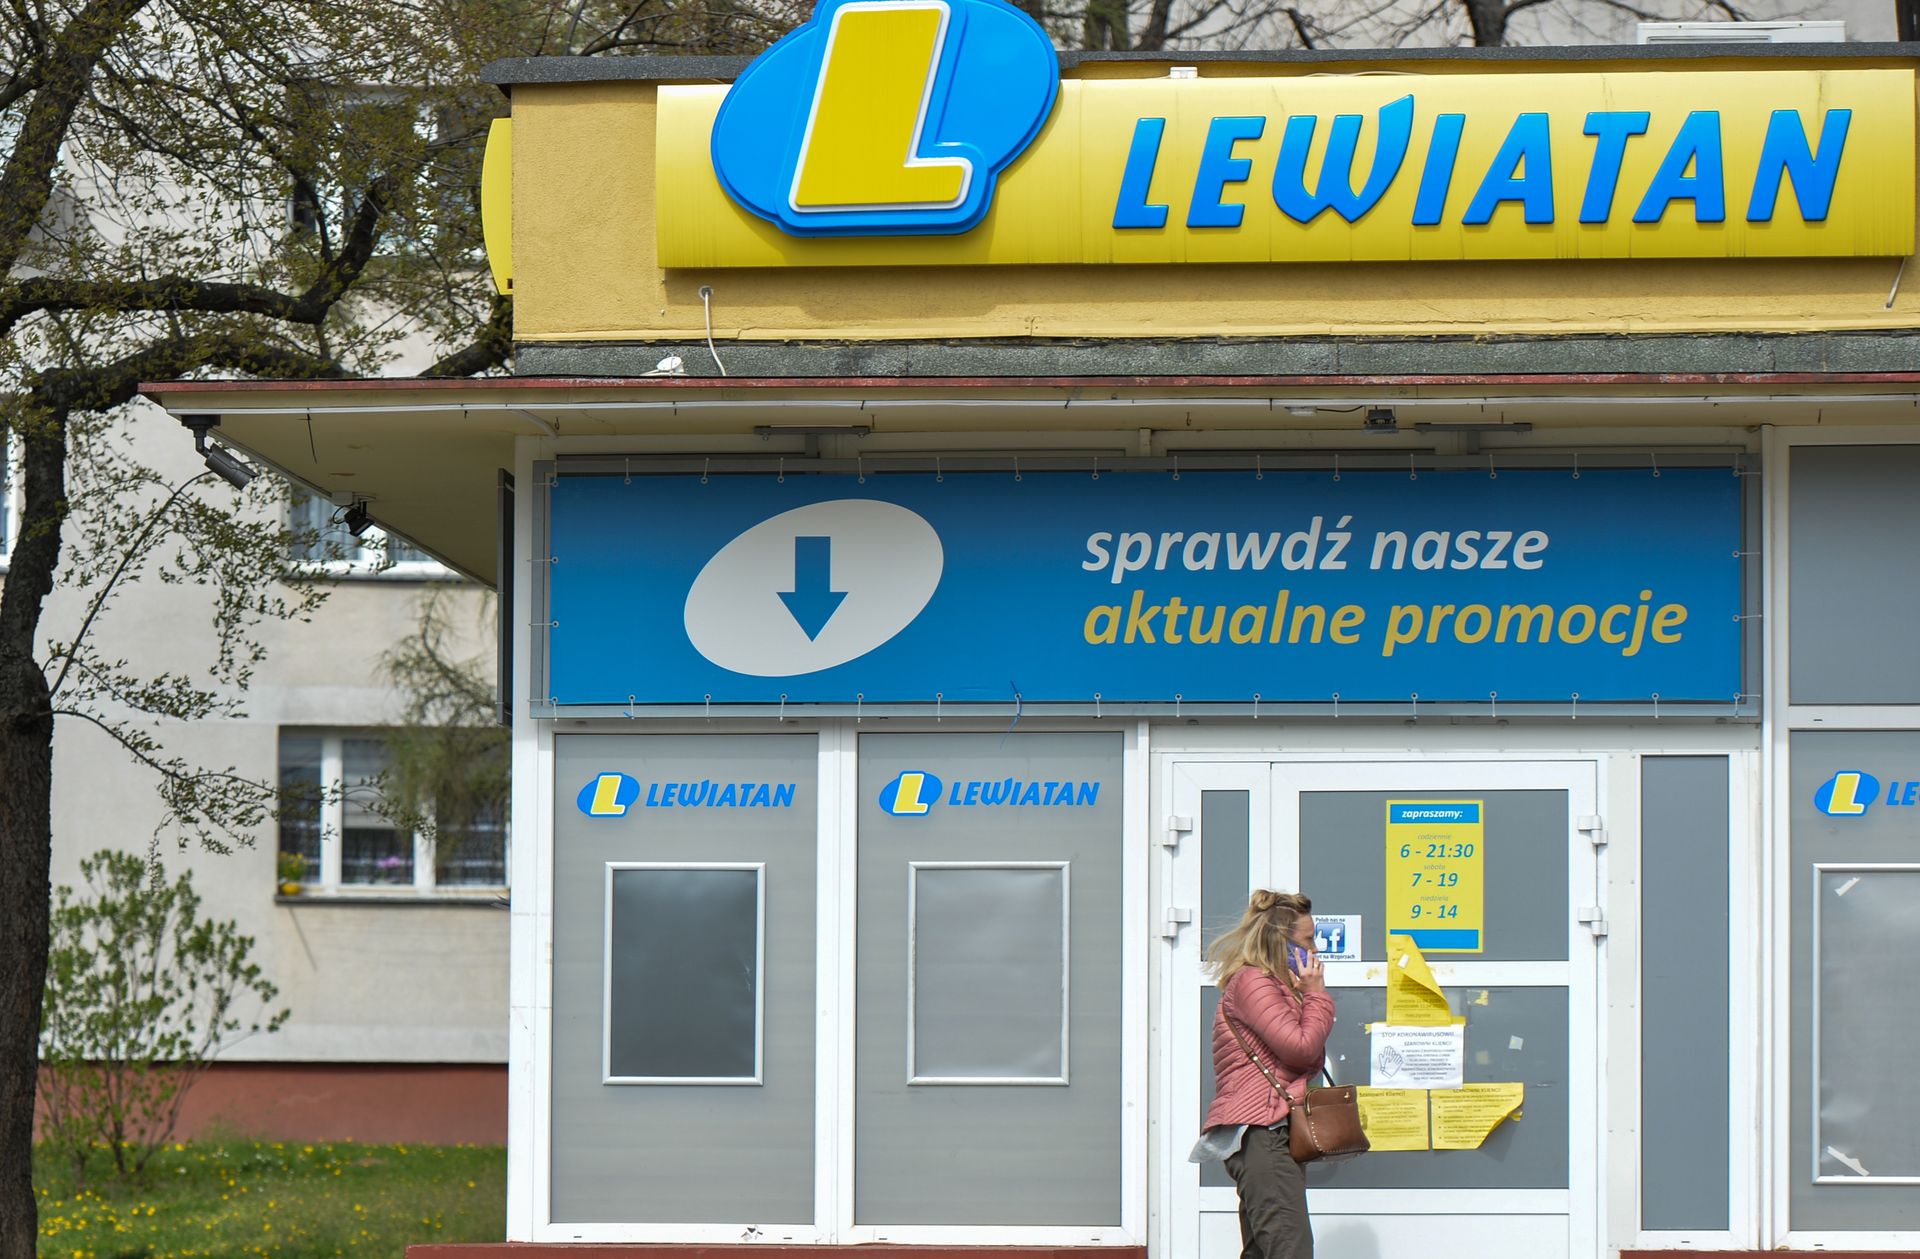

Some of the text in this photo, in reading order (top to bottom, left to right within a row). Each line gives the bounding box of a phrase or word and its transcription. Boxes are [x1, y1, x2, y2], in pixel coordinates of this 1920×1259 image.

[789, 0, 1853, 229] L LEWIATAN
[1082, 515, 1550, 584] sprawdź nasze
[1084, 590, 1689, 657] aktualne promocje
[592, 775, 797, 814] L LEWIATAN
[894, 774, 1101, 813] L LEWIATAN
[1828, 773, 1865, 814] L
[1401, 809, 1464, 820] zapraszamy:
[1400, 843, 1411, 858] 6
[1425, 843, 1475, 858] 21:30
[1411, 872, 1422, 887] 7
[1437, 872, 1459, 887] 19
[1411, 904, 1422, 919] 9
[1437, 904, 1458, 919] 14
